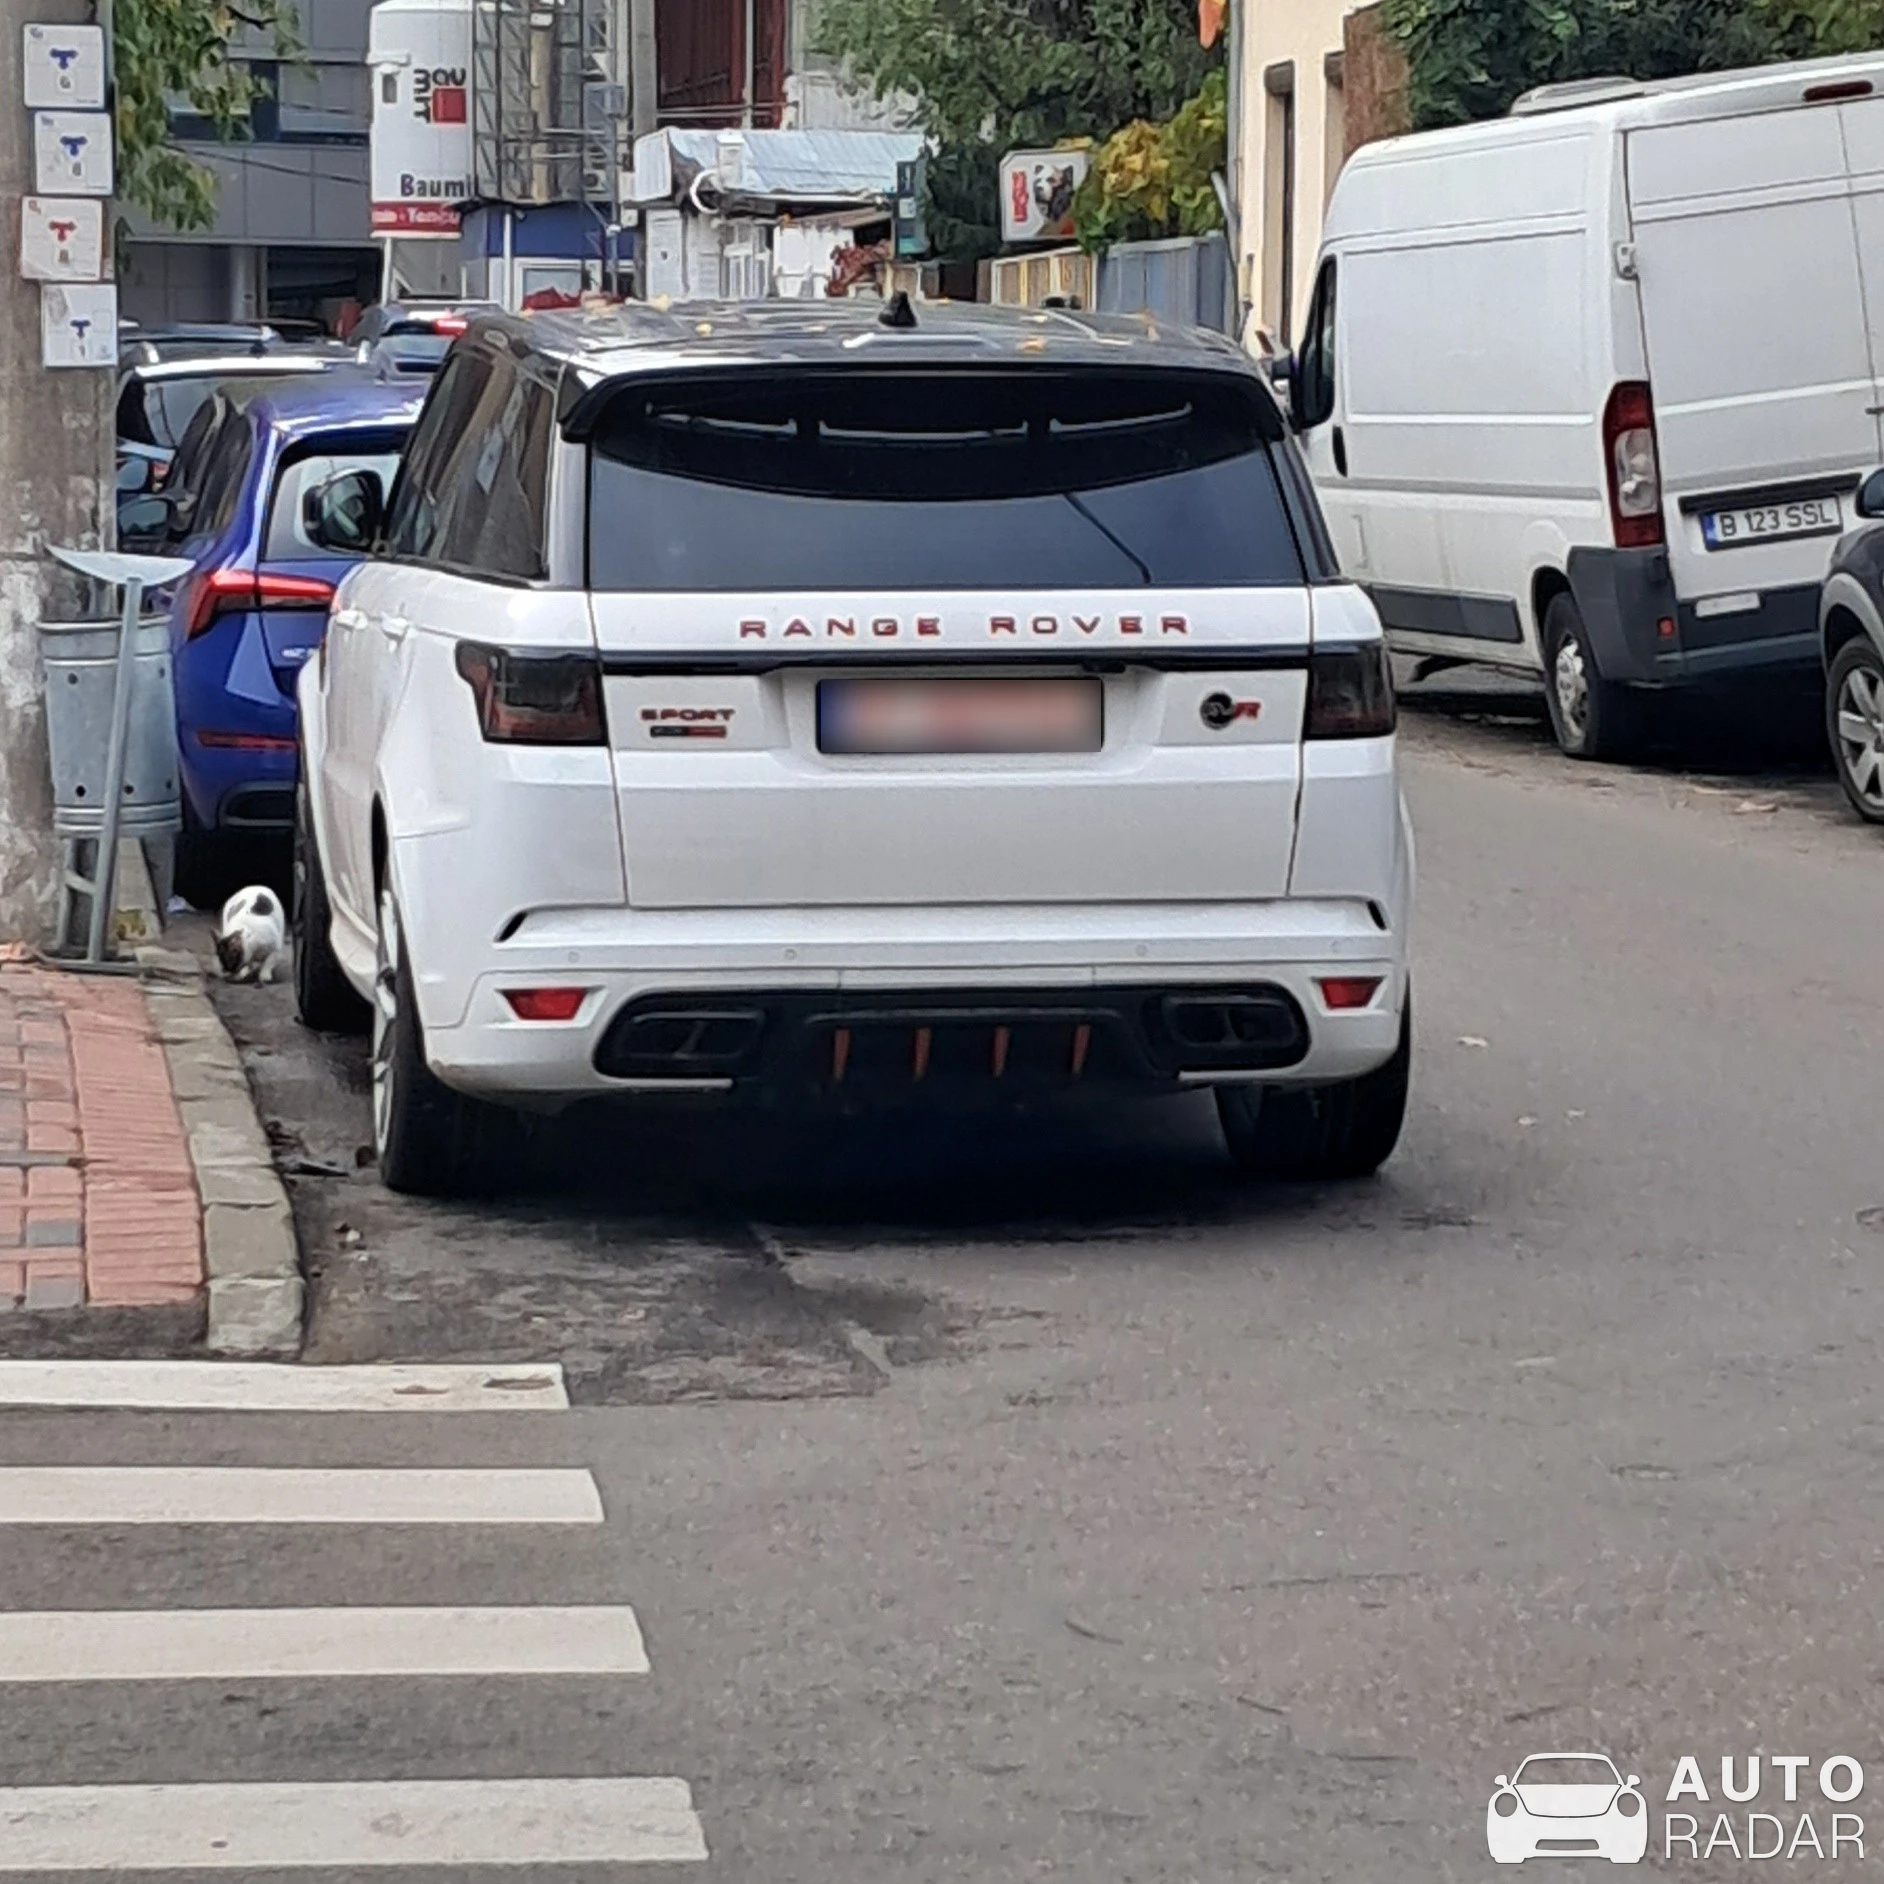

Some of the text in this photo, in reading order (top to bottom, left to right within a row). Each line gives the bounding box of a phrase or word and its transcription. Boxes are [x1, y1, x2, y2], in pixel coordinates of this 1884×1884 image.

[1719, 503, 1833, 537] B 123 SSL
[740, 615, 1188, 638] RANGE ROVER
